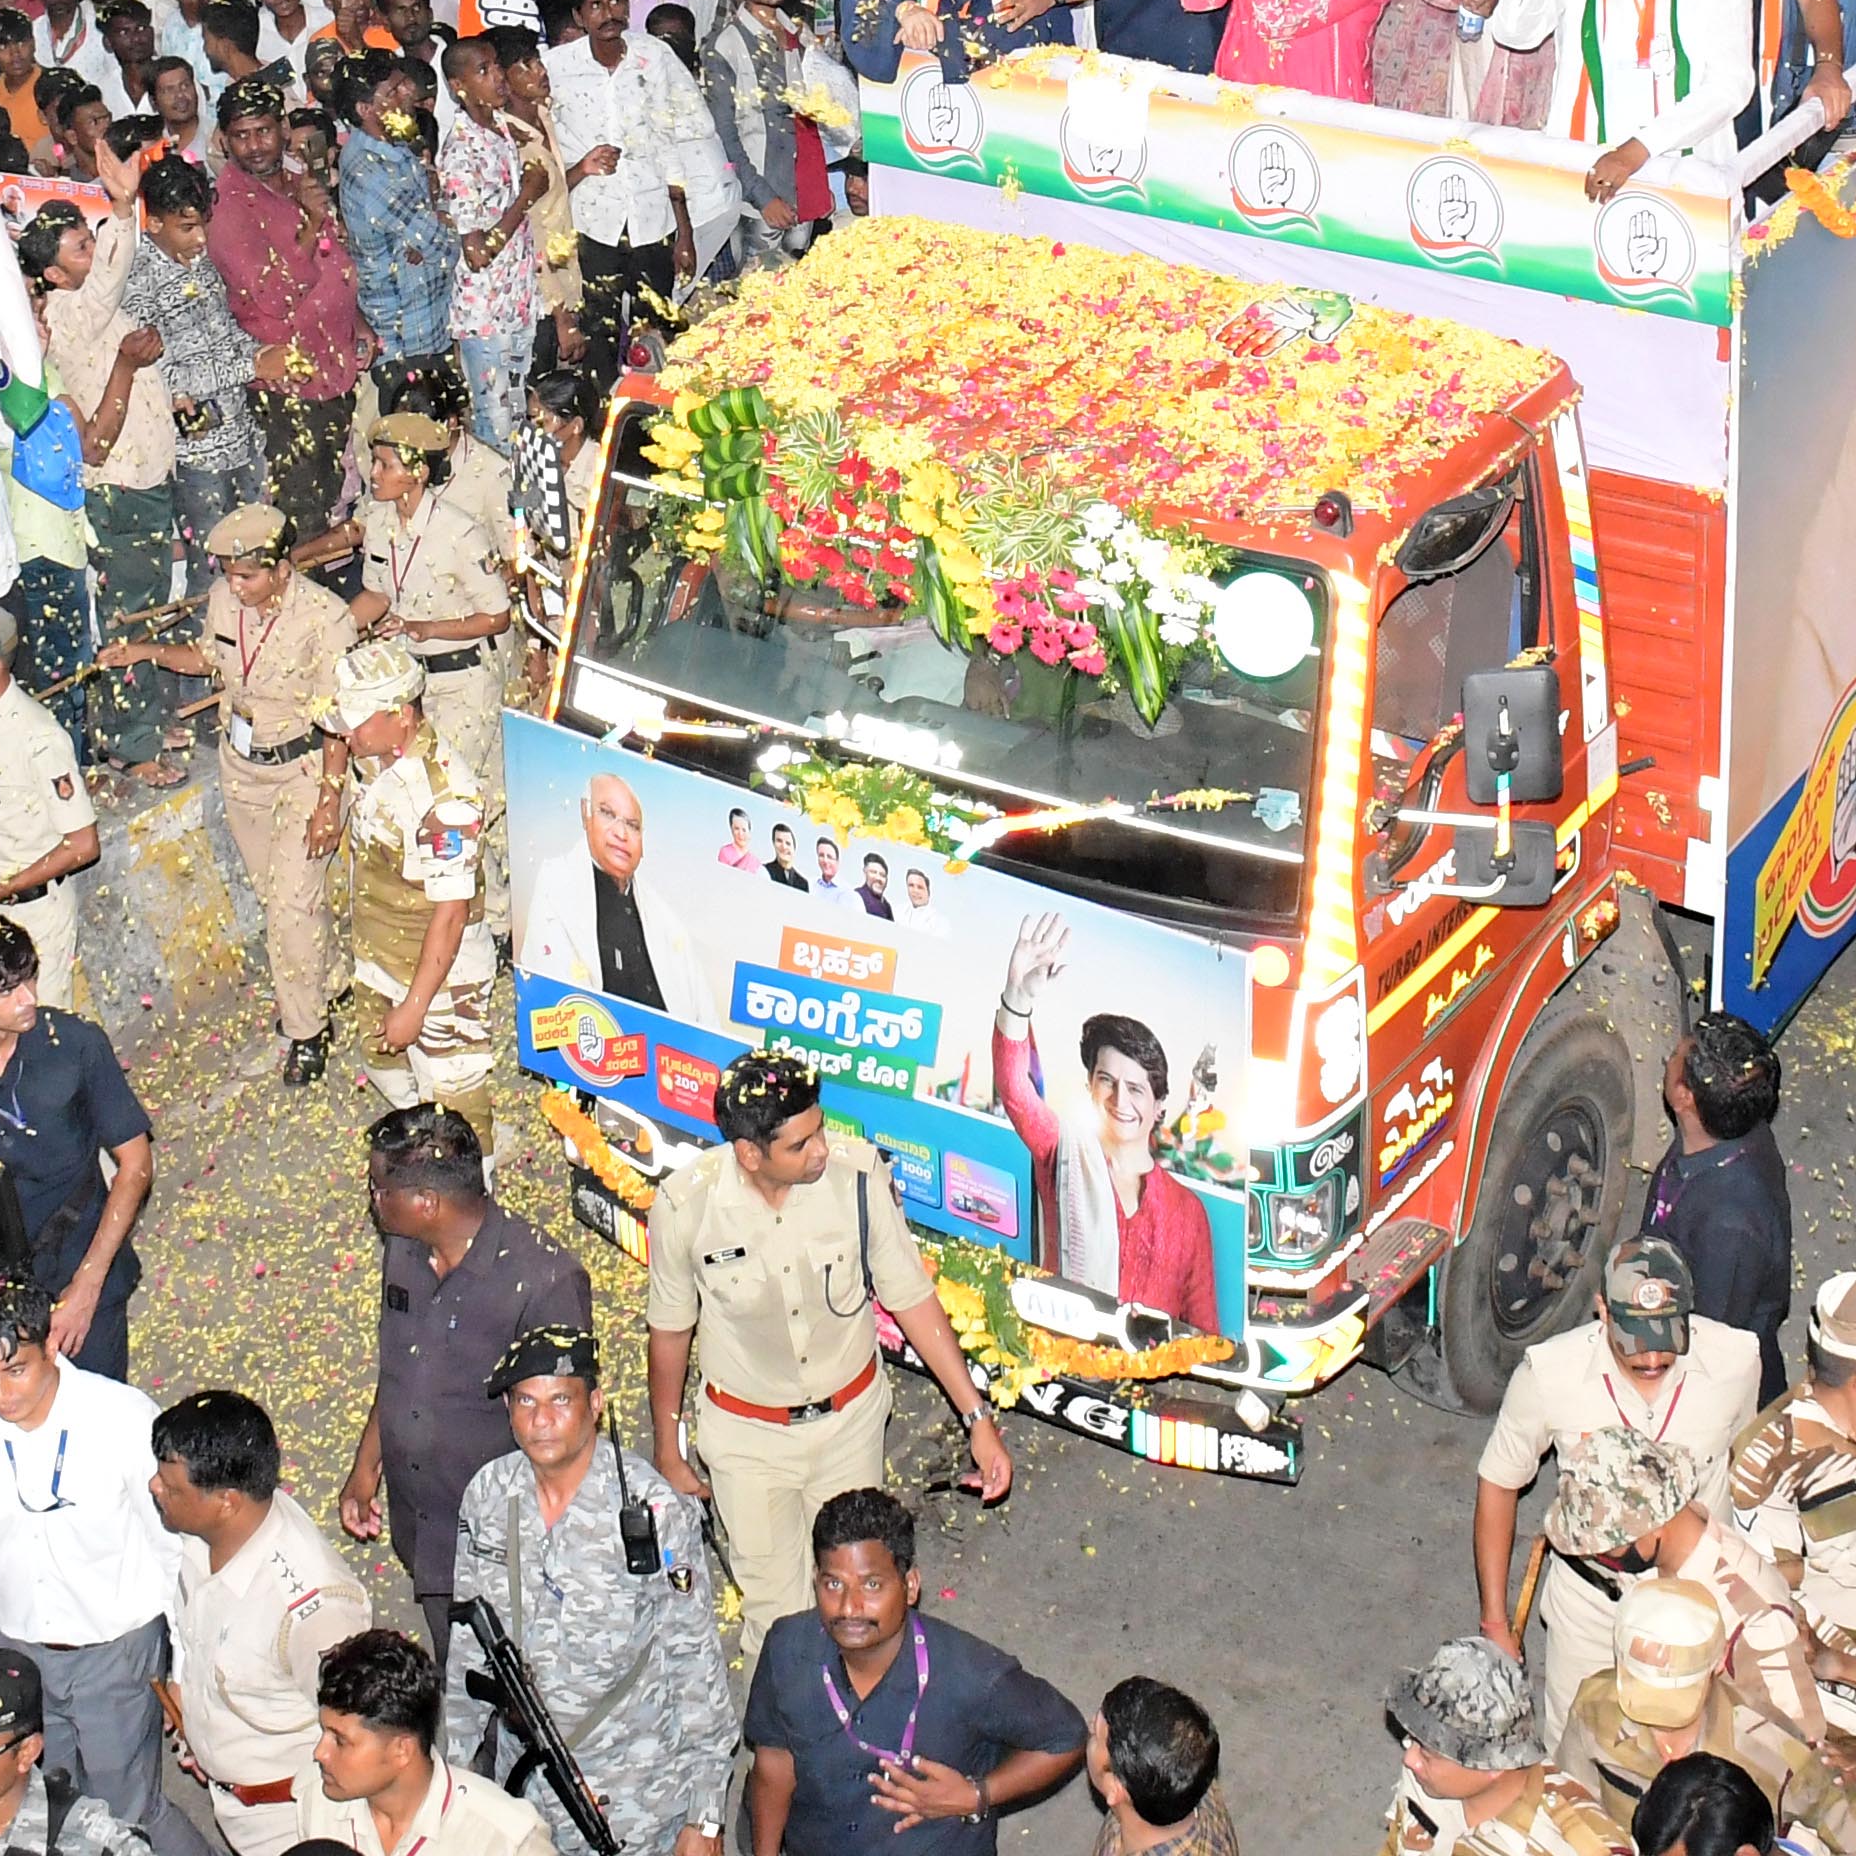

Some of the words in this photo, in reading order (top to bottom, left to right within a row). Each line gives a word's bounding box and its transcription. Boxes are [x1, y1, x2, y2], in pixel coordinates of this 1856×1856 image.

[792, 941, 885, 980] ಬೃಹತ್
[1377, 939, 1422, 1001] TURBO
[745, 980, 924, 1048] ಕಾಂಗ್ರೆಸ್
[674, 1073, 700, 1093] 200
[856, 1055, 910, 1091] ಶೋ
[297, 1599, 320, 1620] KSP
